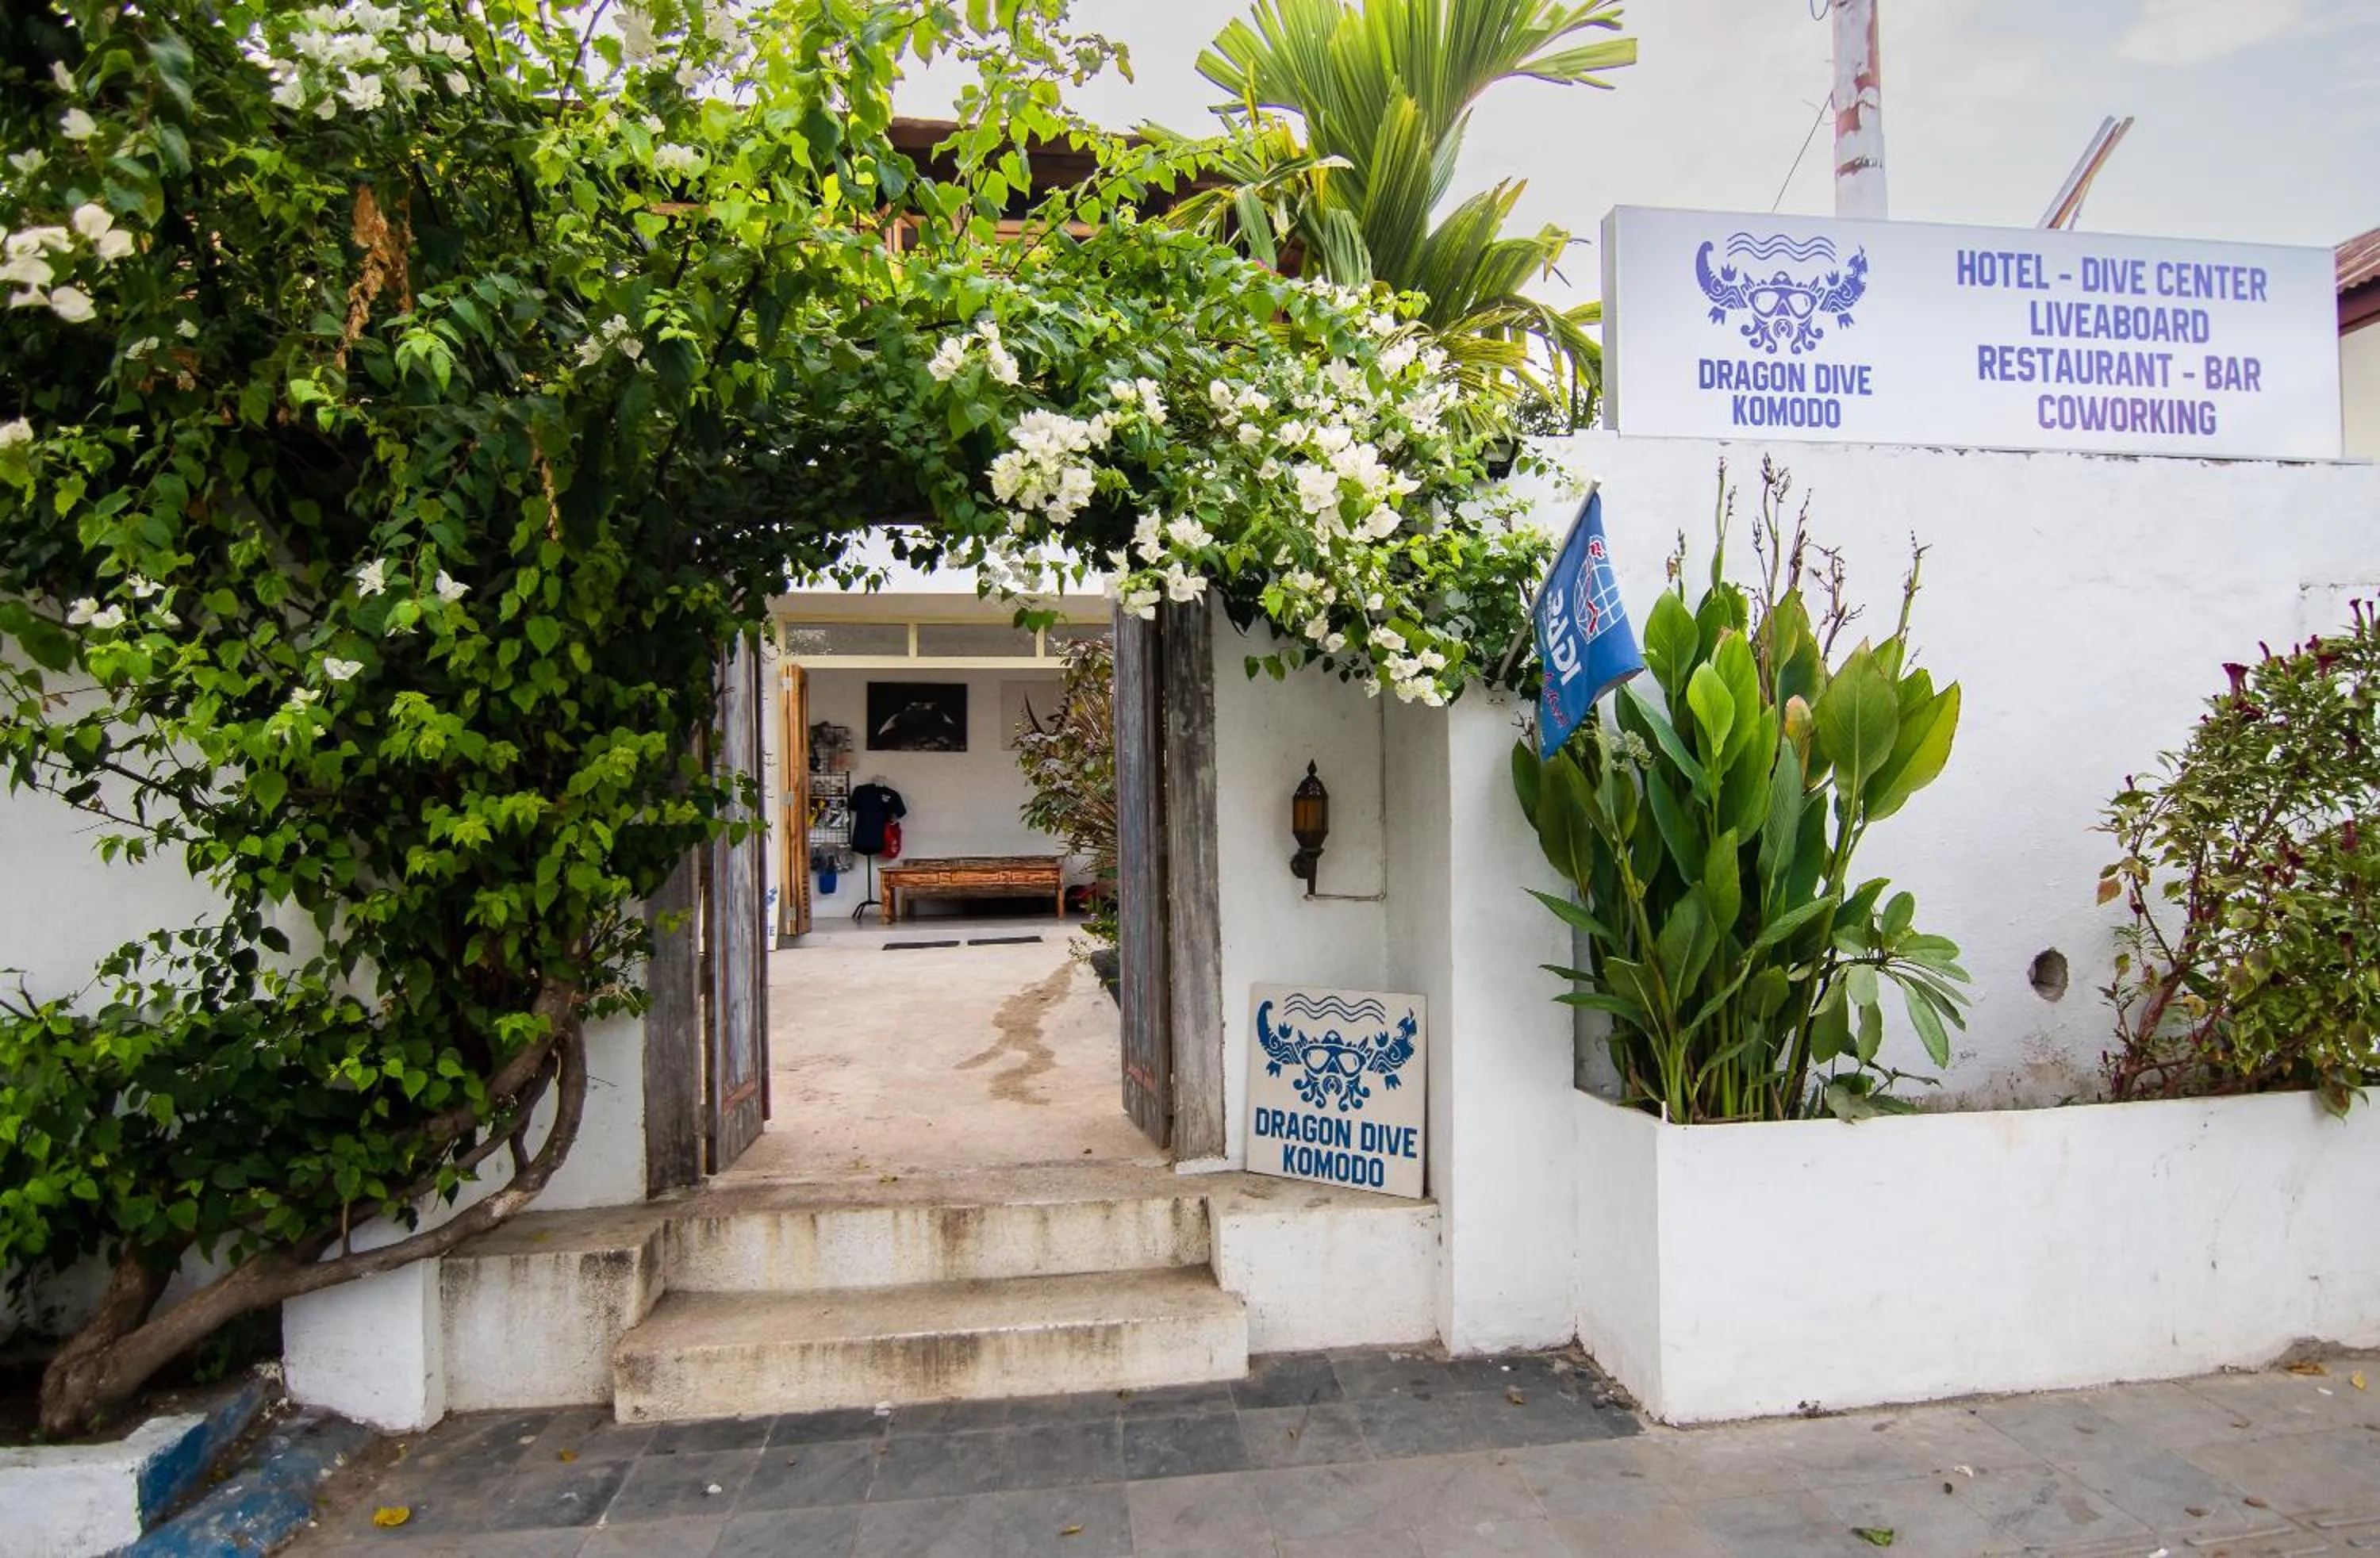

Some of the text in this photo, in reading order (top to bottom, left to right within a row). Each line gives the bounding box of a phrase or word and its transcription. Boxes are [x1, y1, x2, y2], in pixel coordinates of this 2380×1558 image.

[1957, 250, 2050, 290] HOTEL
[2082, 256, 2146, 295] DIVE
[2156, 261, 2267, 302] CENTER
[2030, 300, 2209, 343] LIVEABOARD
[1699, 358, 1873, 396] DRAGON DIVE
[1978, 344, 2173, 388] RESTAURANT
[2205, 355, 2261, 392] BAR
[1733, 394, 1841, 428] KOMODO
[2038, 394, 2217, 436] COWORKING
[1546, 588, 1582, 686] PADI
[1255, 1107, 1418, 1159] DRAGON DIVE
[1282, 1143, 1385, 1188] KOMODO
